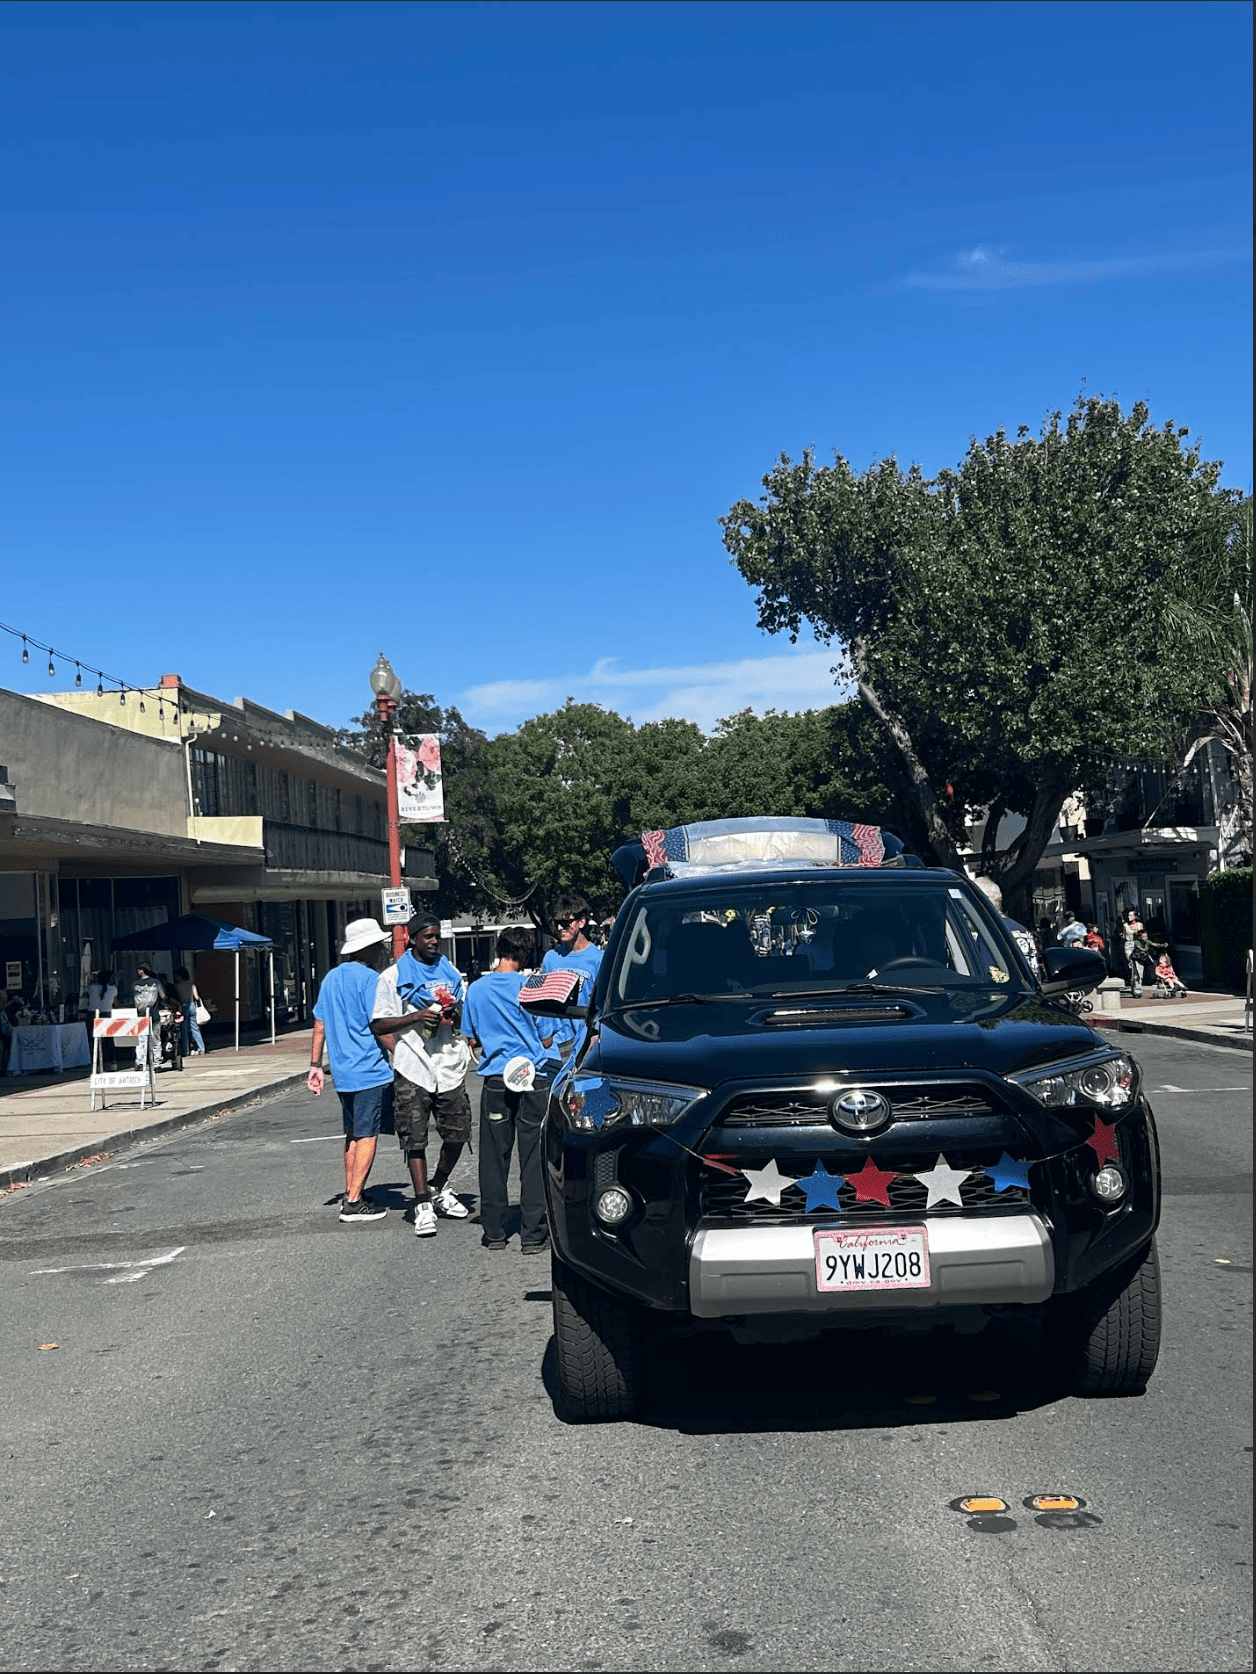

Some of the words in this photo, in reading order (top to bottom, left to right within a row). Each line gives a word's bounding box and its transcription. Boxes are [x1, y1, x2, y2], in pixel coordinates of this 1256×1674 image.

[95, 1077, 106, 1085] CITY
[109, 1076, 116, 1084] OF
[118, 1076, 141, 1084] ANTIOCH
[838, 1235, 906, 1251] California
[826, 1252, 921, 1281] 9YWJ208
